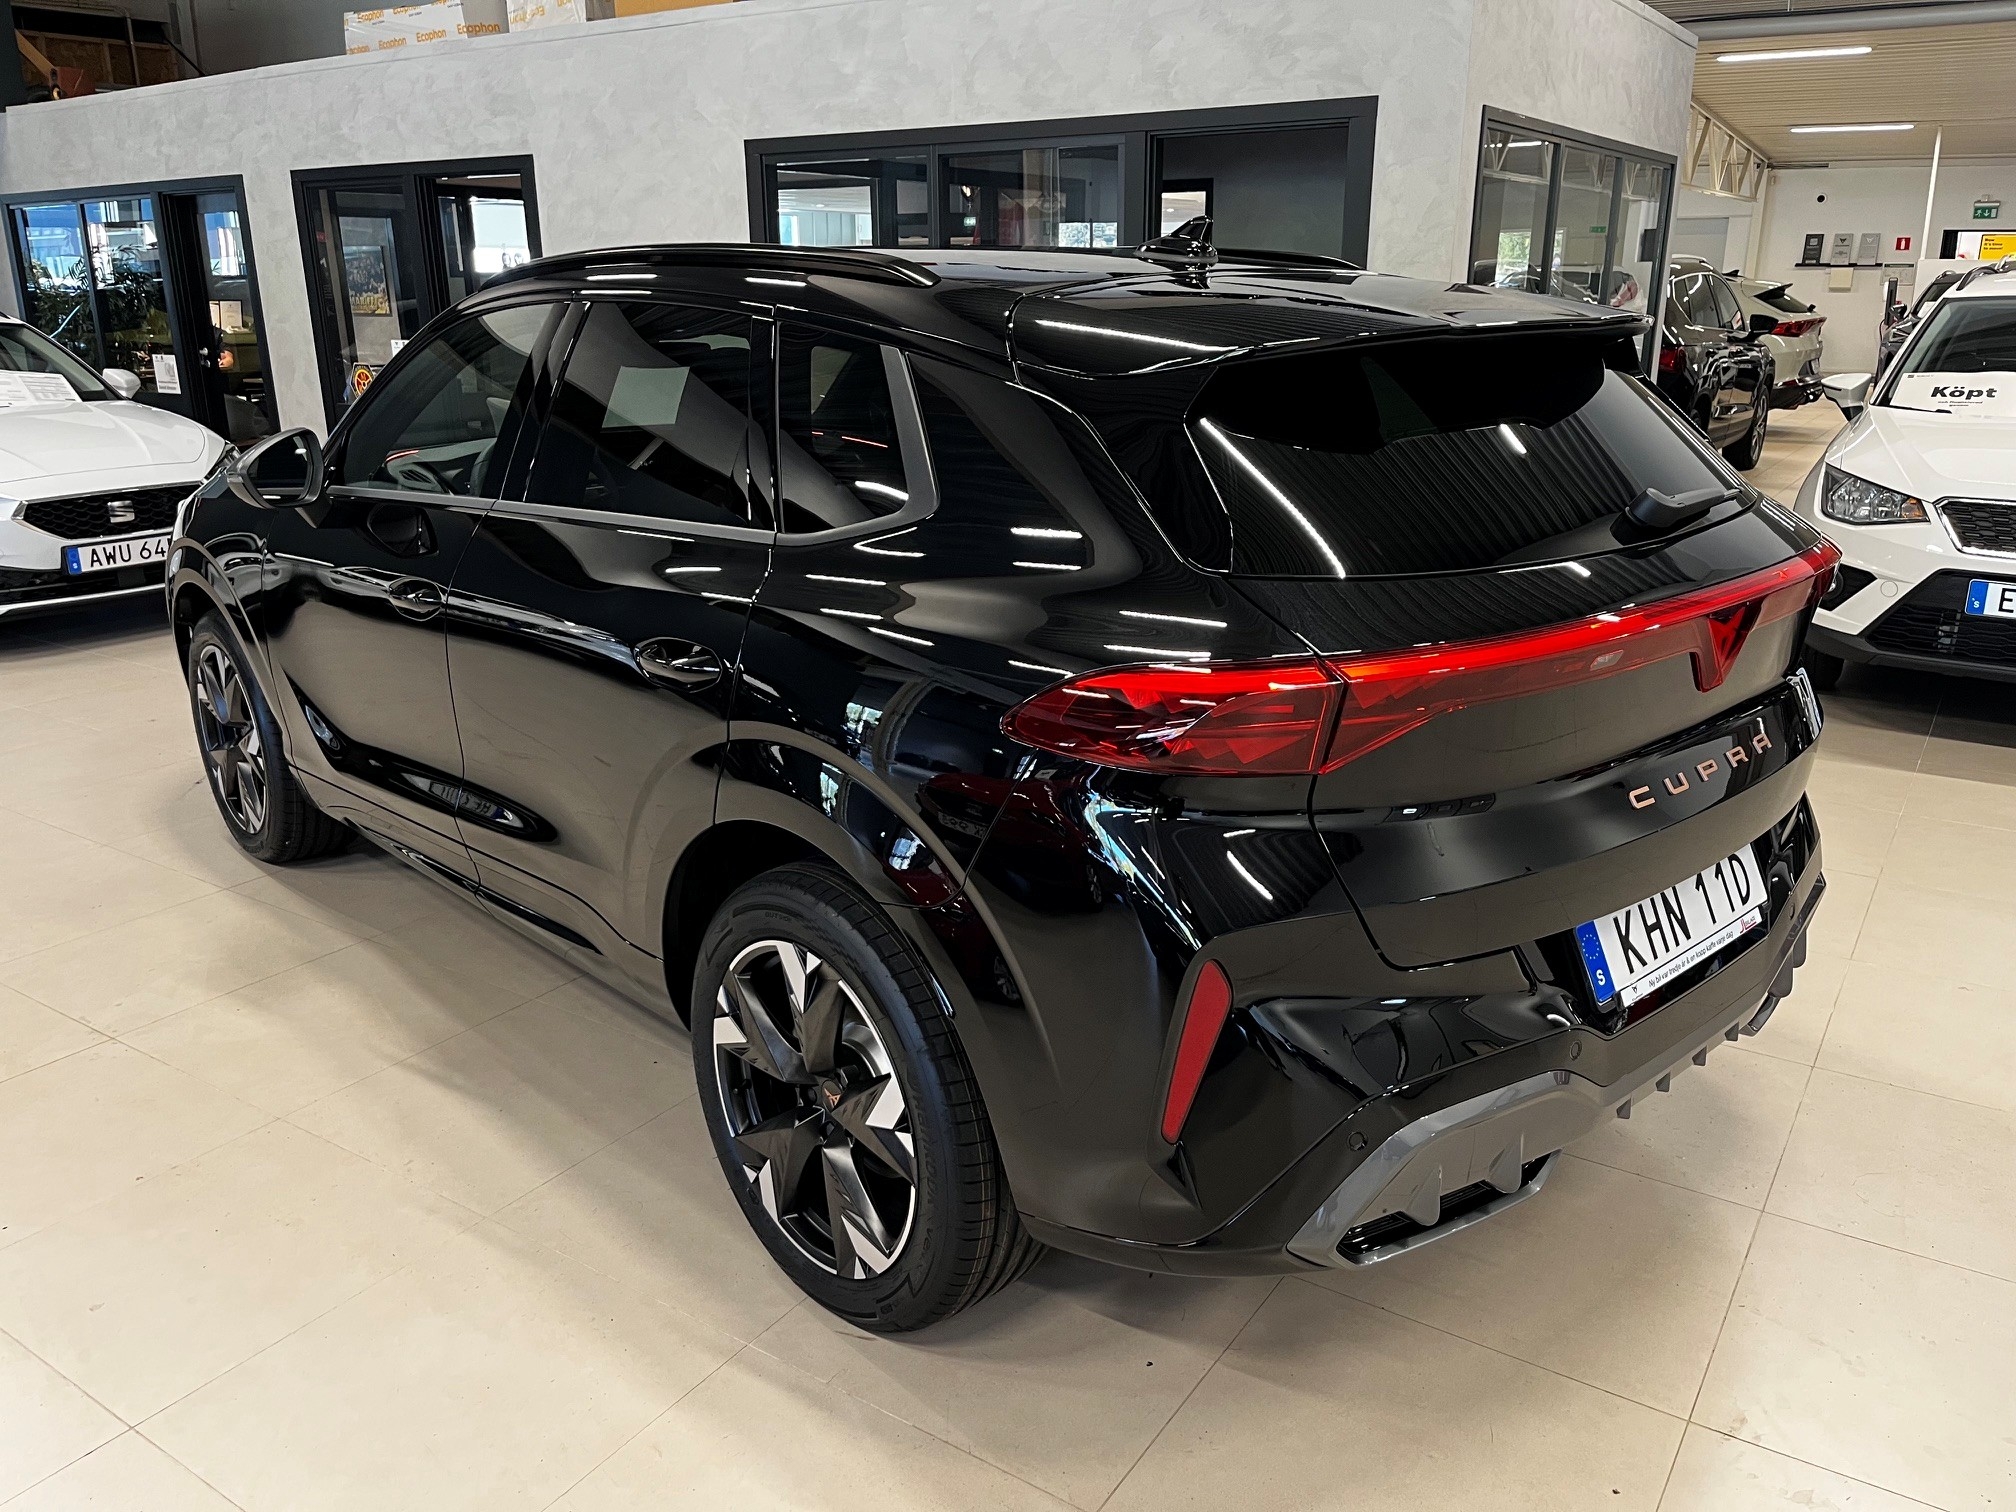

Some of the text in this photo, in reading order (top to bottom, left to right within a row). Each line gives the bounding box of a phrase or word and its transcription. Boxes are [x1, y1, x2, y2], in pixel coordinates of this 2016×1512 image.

[416, 29, 447, 43] Ecophon
[457, 23, 500, 35] Ecophon
[1930, 386, 1997, 400] Köpt
[90, 543, 132, 568] AWU
[139, 537, 171, 560] 64
[1628, 733, 1773, 810] CUPRA
[1595, 853, 1751, 986] S KHN 11D
